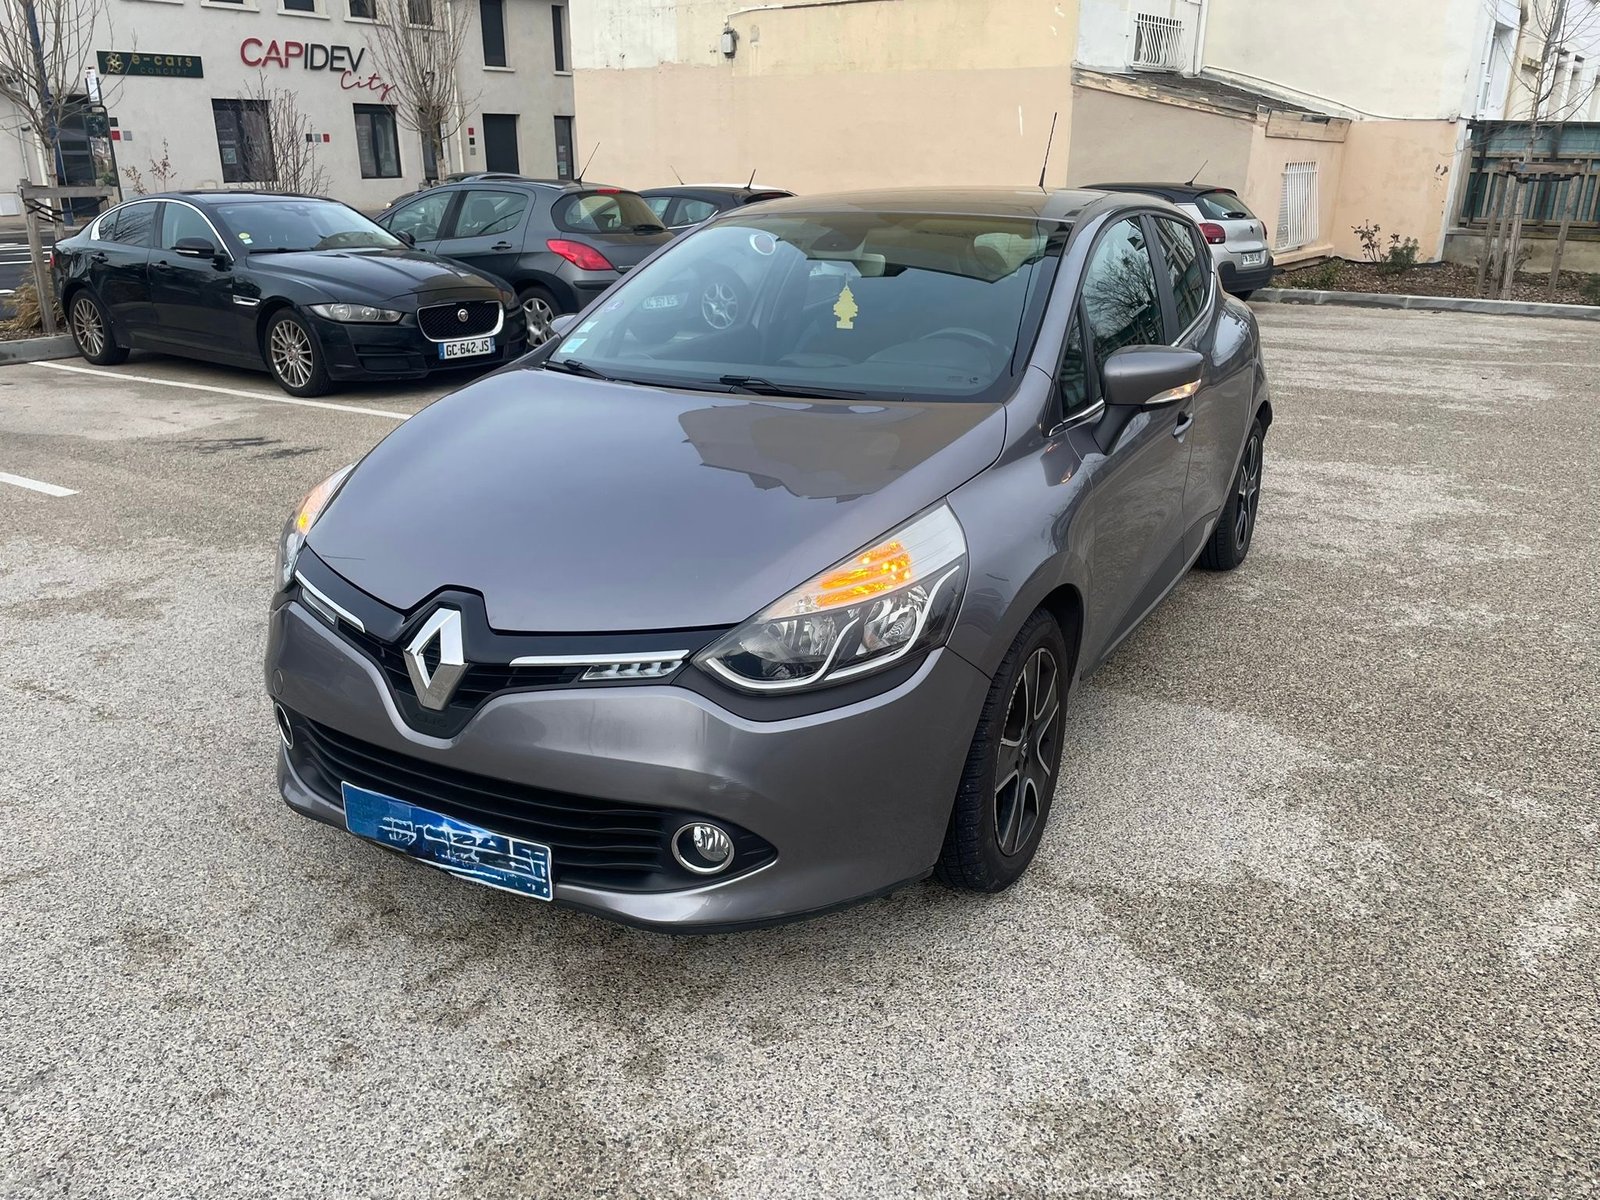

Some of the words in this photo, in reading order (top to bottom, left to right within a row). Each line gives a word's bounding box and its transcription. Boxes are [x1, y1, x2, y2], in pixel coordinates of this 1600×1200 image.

[132, 54, 192, 67] e-cars
[240, 37, 365, 73] CAPIDEV
[340, 70, 396, 101] City
